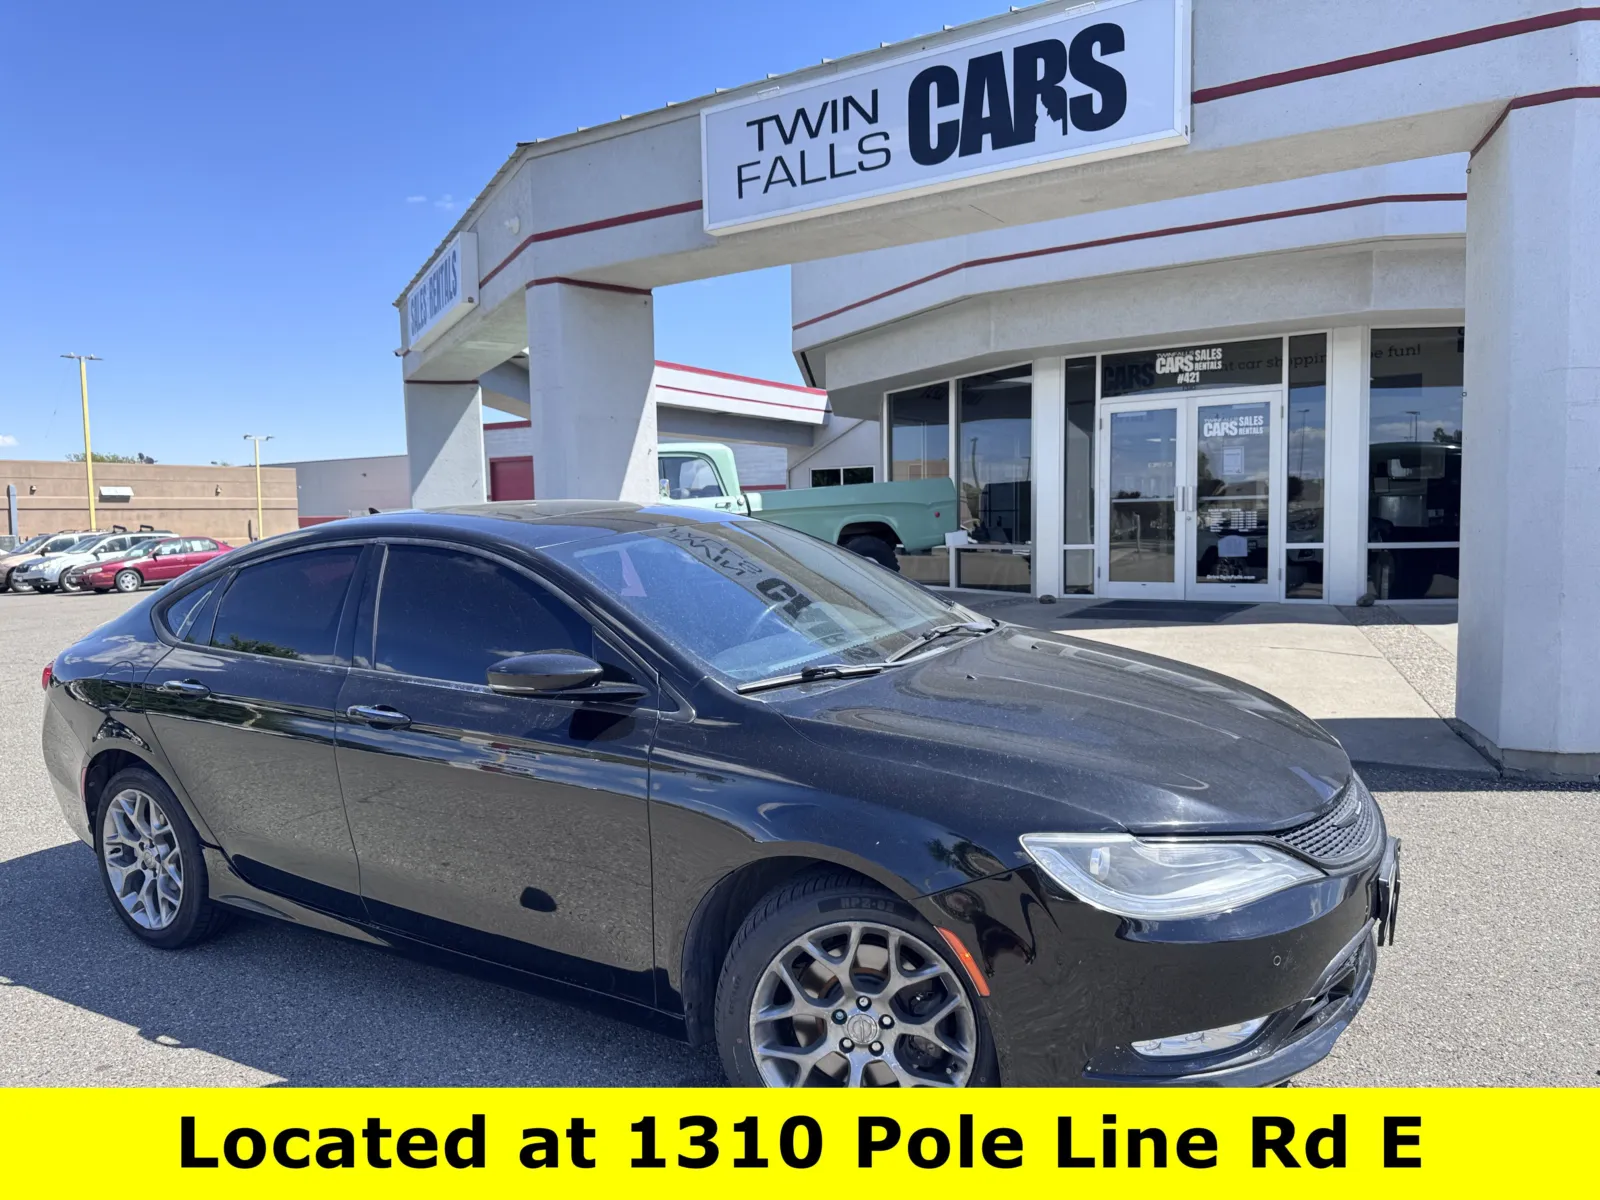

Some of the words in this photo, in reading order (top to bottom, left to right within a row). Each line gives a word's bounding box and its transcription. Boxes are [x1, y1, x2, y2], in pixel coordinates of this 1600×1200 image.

[907, 22, 1127, 166] CARS
[746, 88, 879, 152] TWIN
[737, 130, 891, 199] FALLS
[410, 283, 428, 337] SALES
[428, 250, 458, 319] RENTALS
[1194, 347, 1223, 361] SALES
[1155, 355, 1194, 375] CARS
[1194, 360, 1222, 371] RENTALS
[1177, 371, 1200, 384] #421
[1203, 421, 1238, 437] CARS
[1238, 415, 1264, 427] SALES
[1238, 426, 1264, 436] RENTALS
